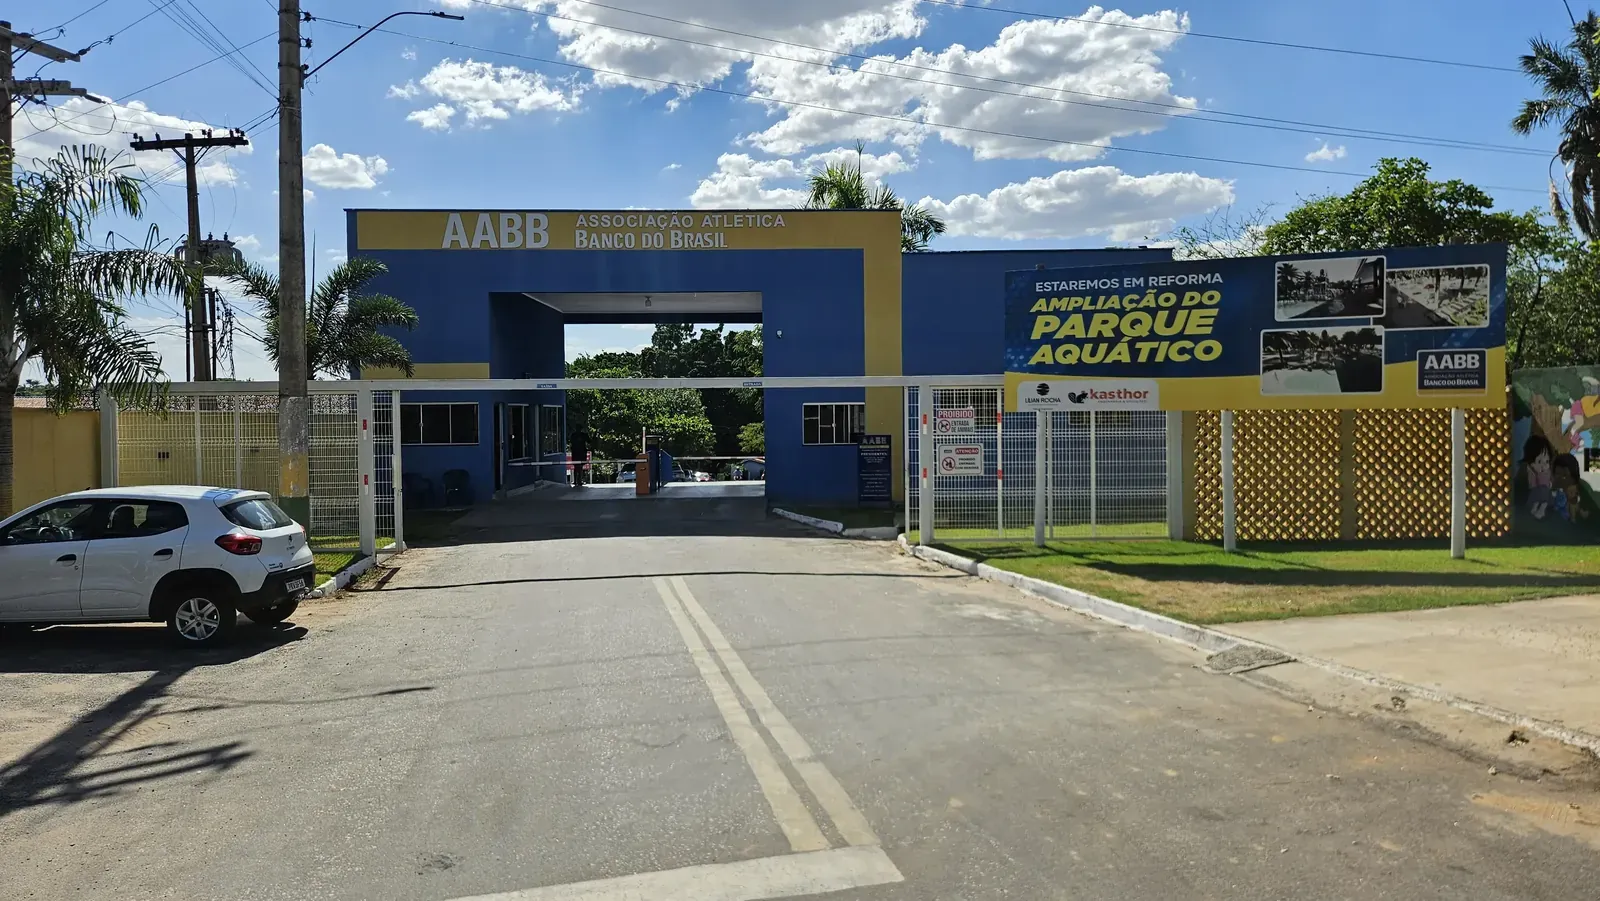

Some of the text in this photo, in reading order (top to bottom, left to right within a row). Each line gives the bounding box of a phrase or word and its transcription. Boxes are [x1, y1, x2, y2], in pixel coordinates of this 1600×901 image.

[441, 211, 550, 249] AABB
[575, 211, 786, 231] ASSOCIAÇÃO ATLETICA
[575, 229, 728, 249] BANCO DO BRASIL
[1035, 272, 1224, 293] ESTAREMOS EM REFORMA
[1029, 289, 1222, 313] AMPLIAÇÃO DO
[1030, 308, 1219, 340] PARQUE
[1028, 336, 1223, 365] AQUÁTICO
[1424, 354, 1479, 370] AABB
[1456, 378, 1479, 386] BRASIL
[1089, 388, 1149, 399] kasthor
[938, 410, 973, 418] PROIBIDO
